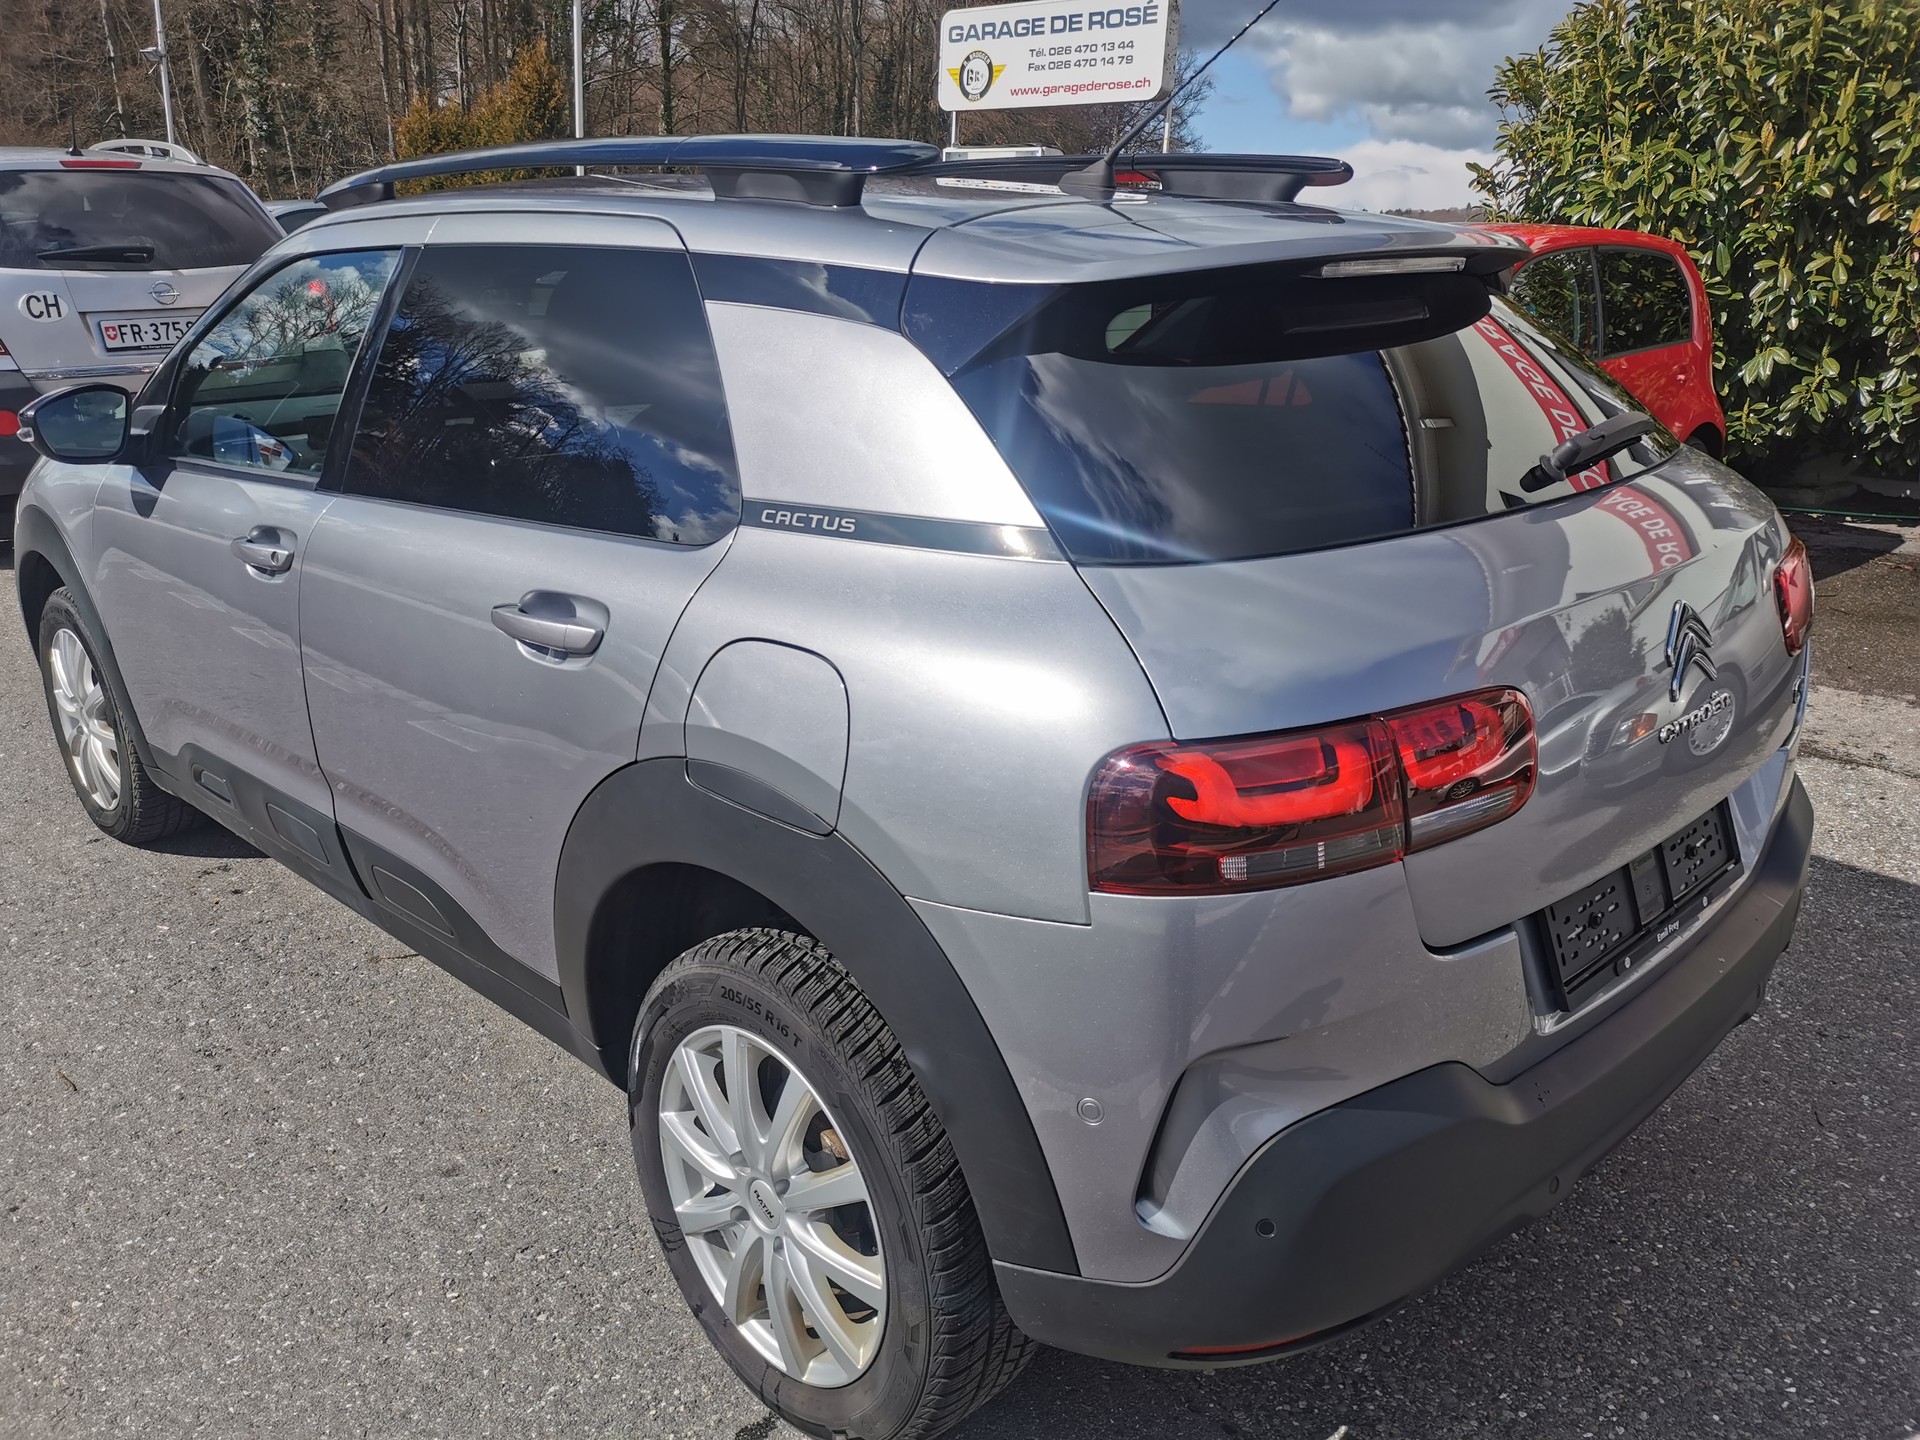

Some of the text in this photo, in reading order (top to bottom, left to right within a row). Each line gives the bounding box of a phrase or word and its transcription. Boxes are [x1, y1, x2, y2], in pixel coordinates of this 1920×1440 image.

[948, 0, 1159, 43] GARAGE DE ROSÉ
[1029, 40, 1135, 58] Tél. 026 470 13 44
[1027, 54, 1134, 72] Fax 026 470 14 79
[1010, 77, 1152, 97] www.garagederose.ch
[26, 294, 62, 319] CH
[761, 509, 857, 533] CACTUS
[1656, 920, 1680, 943] Emil Frey
[720, 985, 762, 1016] 205/55
[793, 1032, 803, 1047] T
